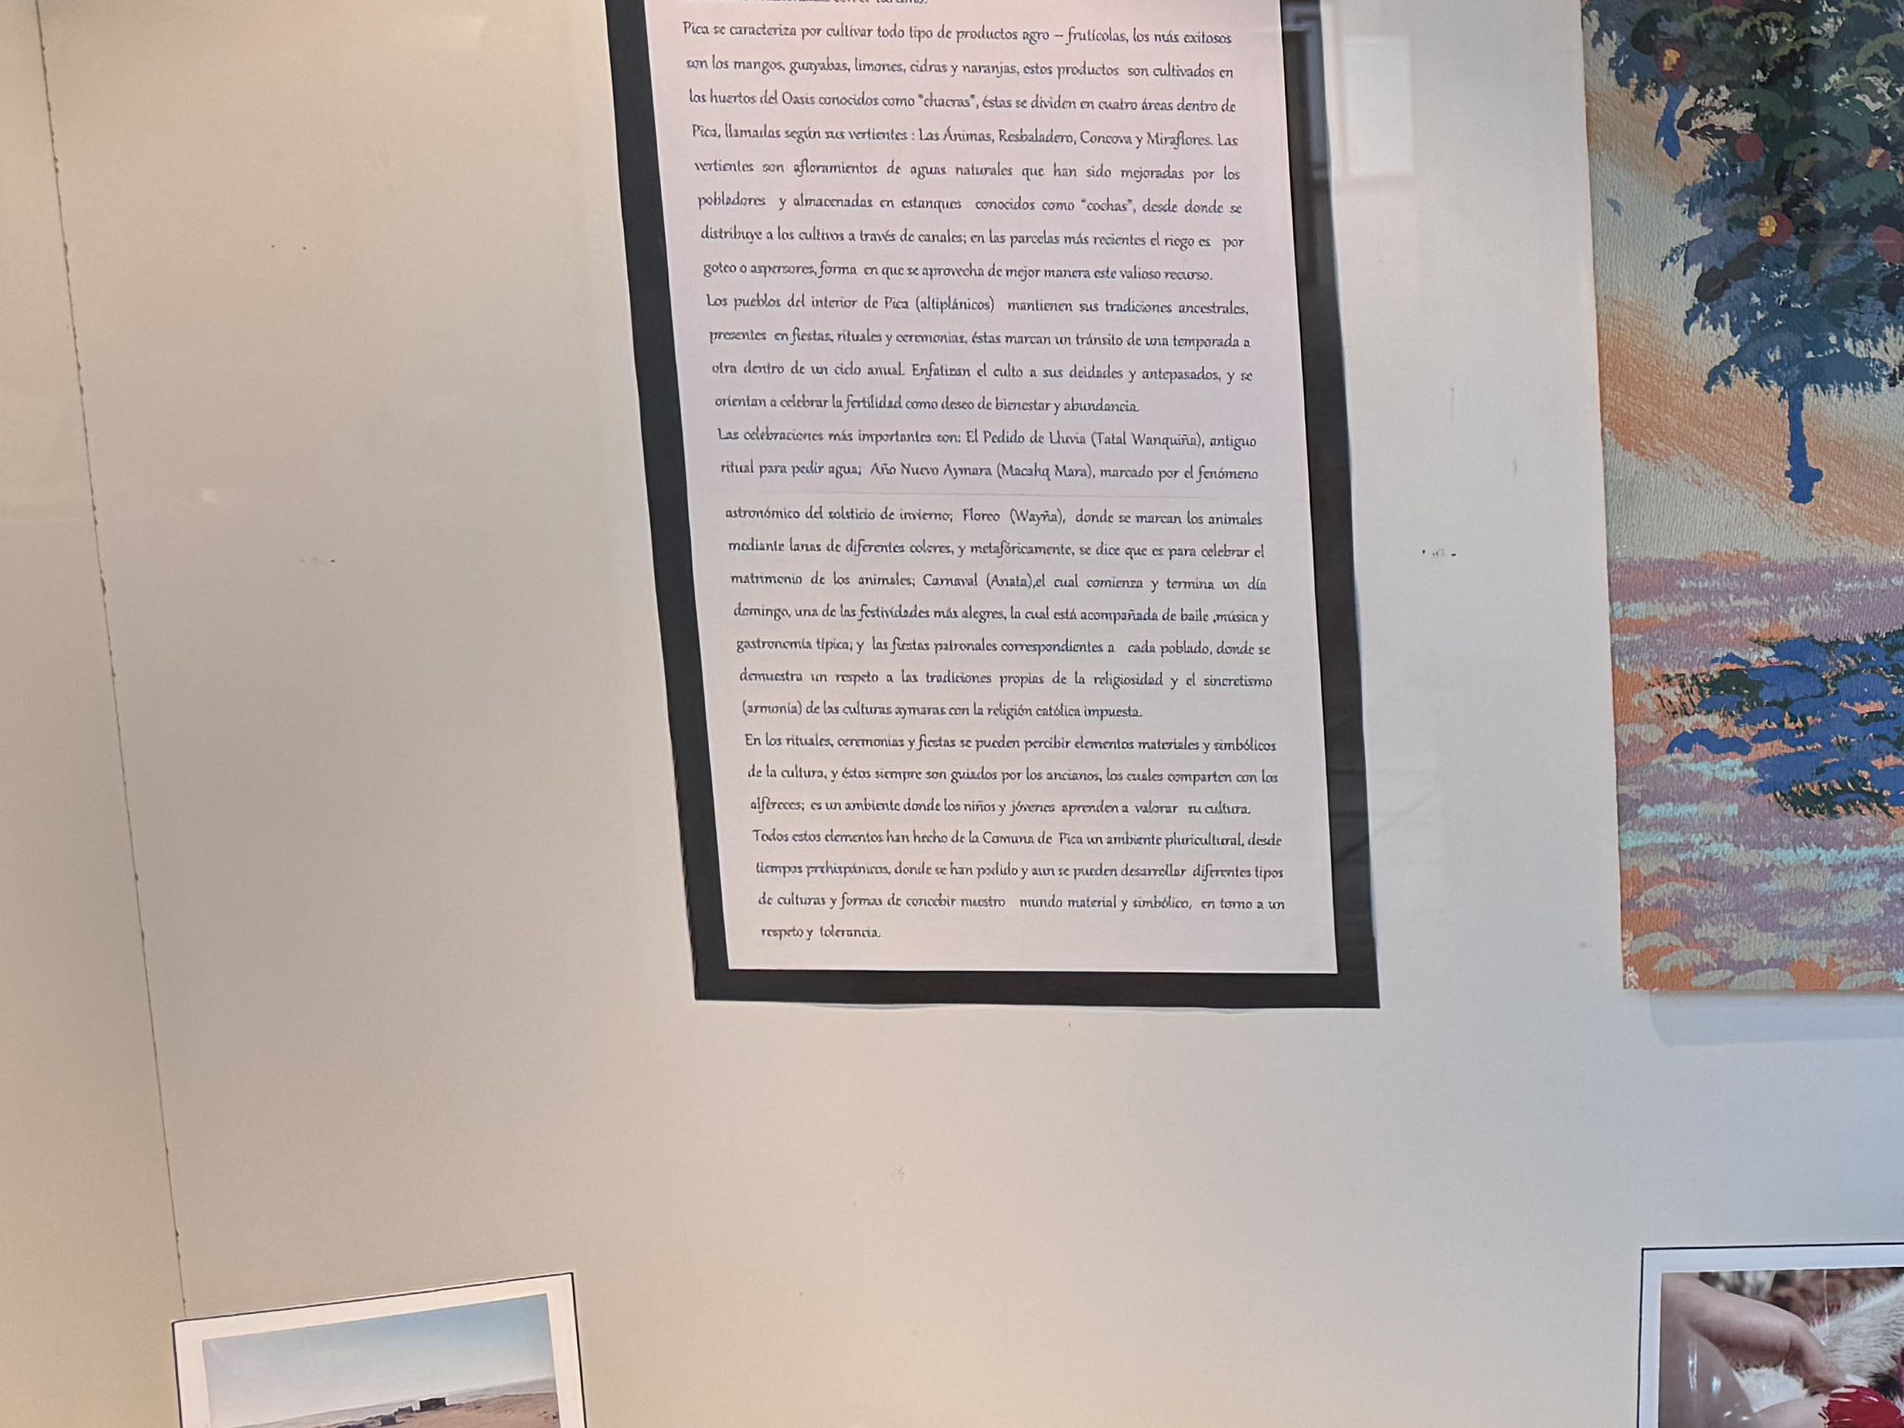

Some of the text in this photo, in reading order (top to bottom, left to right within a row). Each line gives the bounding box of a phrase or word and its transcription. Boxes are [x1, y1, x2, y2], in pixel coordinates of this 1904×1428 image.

[693, 156, 1241, 184] vertientes son afloramientos de aguas naturales que han sido mejoradas por los
[704, 292, 728, 307] Los
[732, 291, 782, 312] pueblos
[785, 291, 806, 308] del
[810, 294, 858, 309] interior
[862, 293, 879, 309] de
[883, 294, 910, 310] Pica
[1006, 298, 1073, 312] mantienen
[1078, 301, 1099, 313] sus
[1103, 296, 1173, 314] tradiciones
[716, 426, 740, 441] Las
[742, 424, 824, 442] celebraciones
[826, 428, 854, 442] más
[857, 428, 932, 446] importantes
[964, 427, 979, 443] El
[981, 427, 1025, 444] Pedido
[1028, 428, 1045, 444] de
[1089, 429, 1127, 448] (Tatal
[1208, 433, 1257, 452] antiguo
[724, 505, 801, 520] astronómico
[803, 503, 824, 520] del
[827, 504, 876, 521] solsticio
[878, 505, 895, 521] de
[961, 506, 1001, 522] Floreo
[1074, 506, 1114, 524] donde
[1117, 513, 1132, 524] se
[1133, 514, 1183, 525] marcan
[1185, 509, 1204, 525] los
[1206, 509, 1263, 526] animales
[804, 698, 821, 715] de
[822, 698, 840, 715] las
[841, 699, 893, 715] culturas
[893, 705, 947, 720] aymaras
[947, 706, 970, 716] con
[972, 700, 984, 716] la
[985, 700, 1033, 721] religión
[1034, 701, 1081, 717] católica
[750, 826, 789, 843] Todos
[790, 829, 822, 843] estos
[823, 827, 884, 843] elementos
[885, 827, 910, 843] han
[911, 827, 948, 844] hecho
[949, 828, 966, 844] de
[967, 828, 980, 844] la
[981, 829, 1035, 845] Comuna
[1036, 829, 1053, 845] de
[1057, 830, 1084, 845] Pica
[1085, 835, 1104, 845] un
[1105, 829, 1163, 846] ambiente
[1246, 830, 1283, 847] desde
[759, 924, 804, 941] respeto
[804, 927, 814, 941] y
